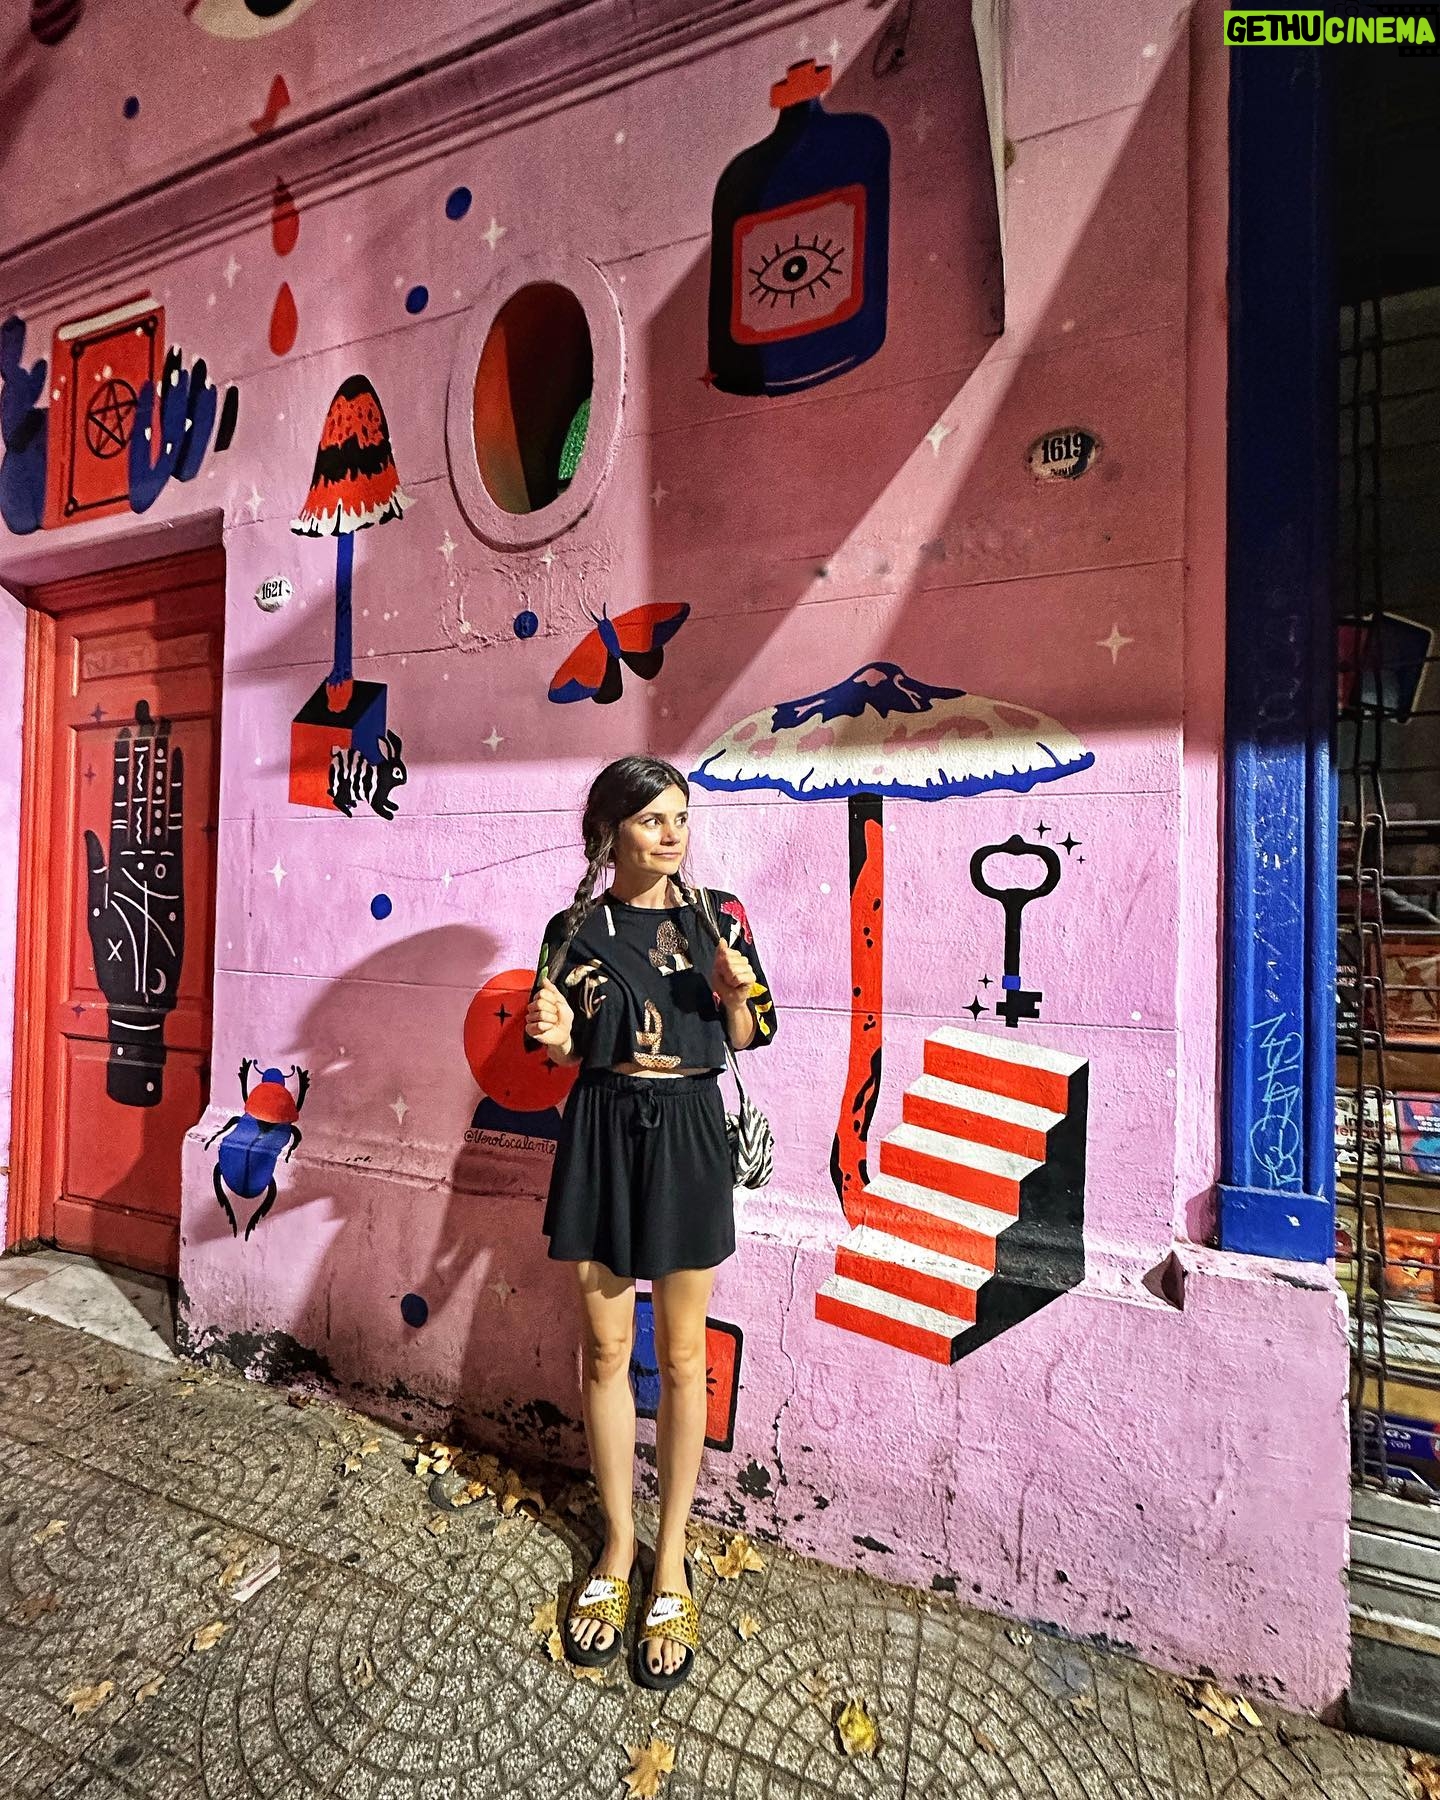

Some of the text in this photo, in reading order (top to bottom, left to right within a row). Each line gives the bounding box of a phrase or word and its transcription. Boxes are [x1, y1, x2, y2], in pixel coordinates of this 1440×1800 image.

[1042, 432, 1083, 464] 1619
[262, 580, 283, 600] 1621
[464, 1129, 557, 1155] @VeroEscalante
